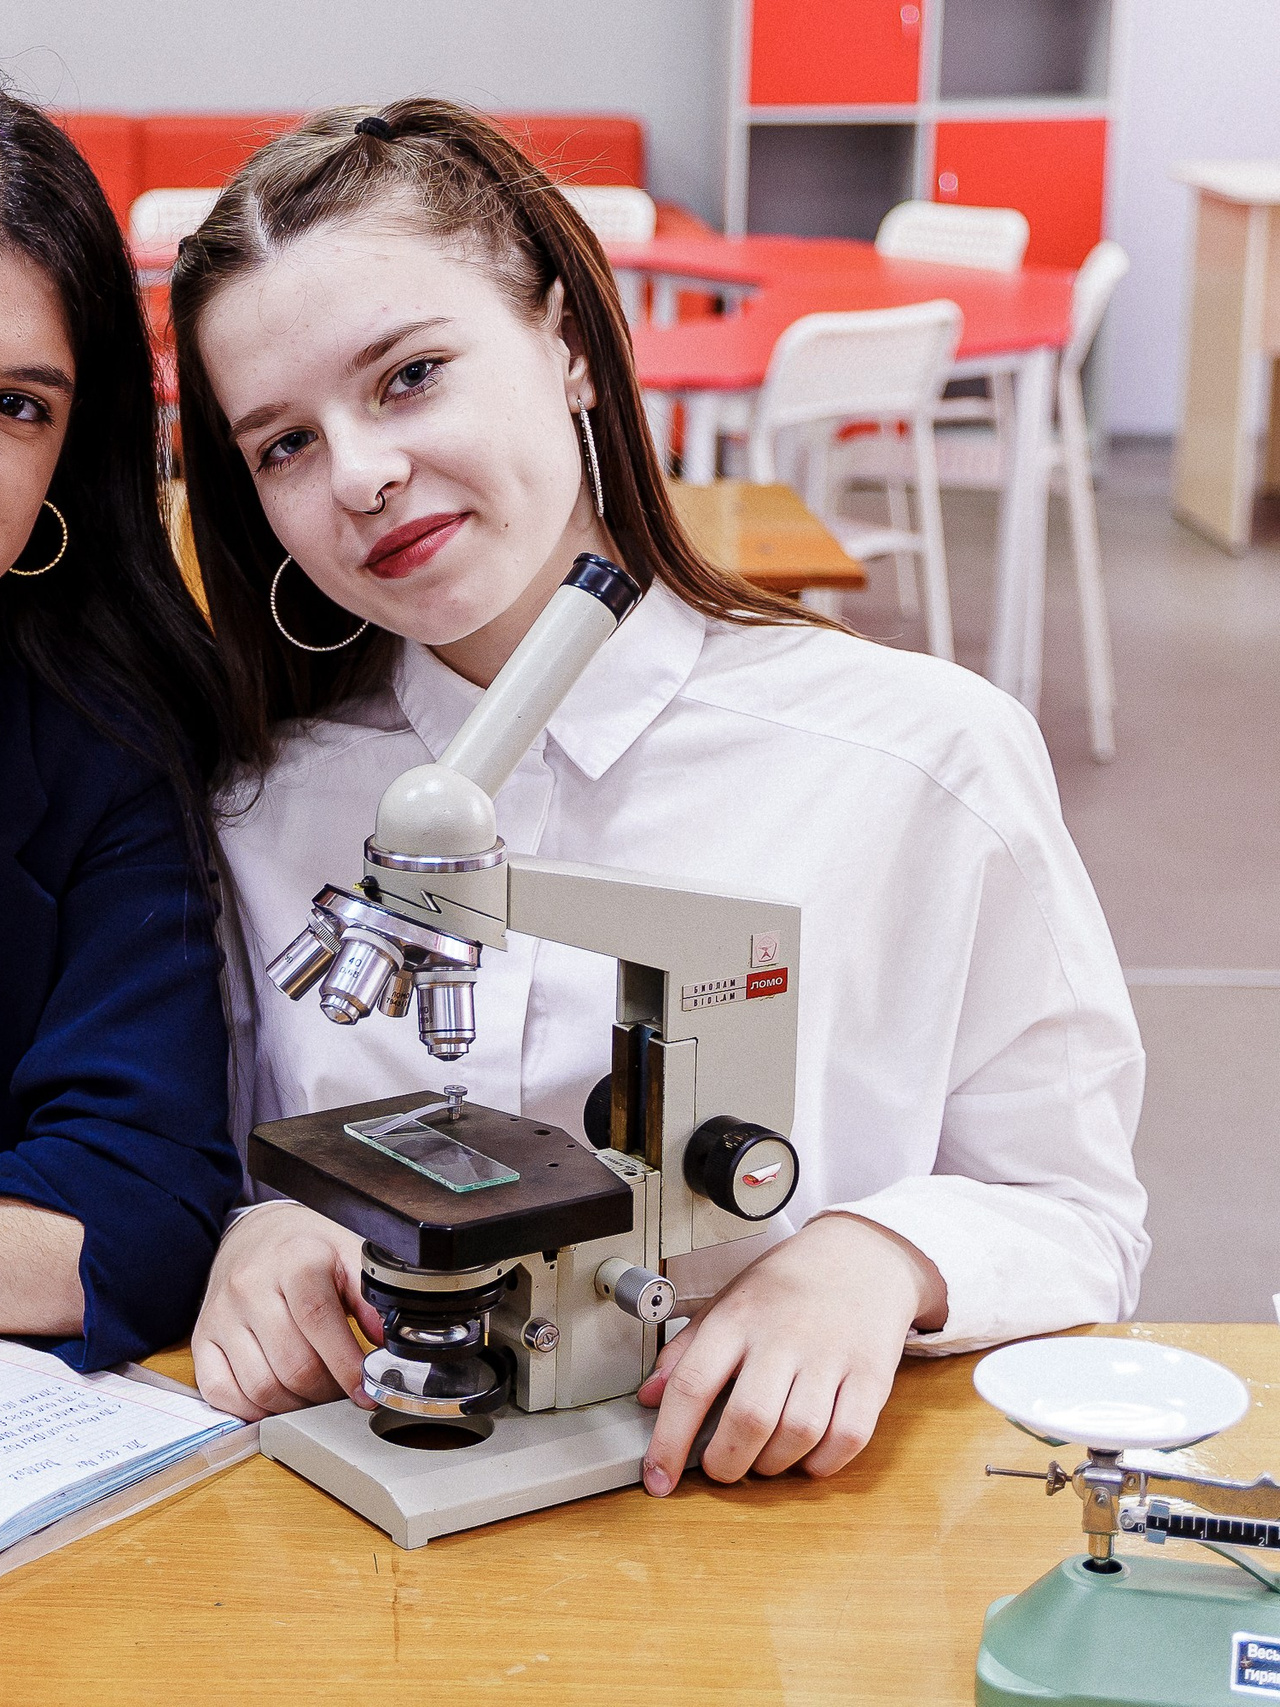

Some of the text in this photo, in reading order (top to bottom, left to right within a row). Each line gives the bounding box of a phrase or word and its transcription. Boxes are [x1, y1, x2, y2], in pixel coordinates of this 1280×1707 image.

[693, 979, 736, 994] БИОЛАМ
[750, 976, 783, 991] ЛОМО
[693, 992, 736, 1007] BIOLAM
[1137, 1523, 1145, 1533] 0
[1258, 1536, 1266, 1547] 2
